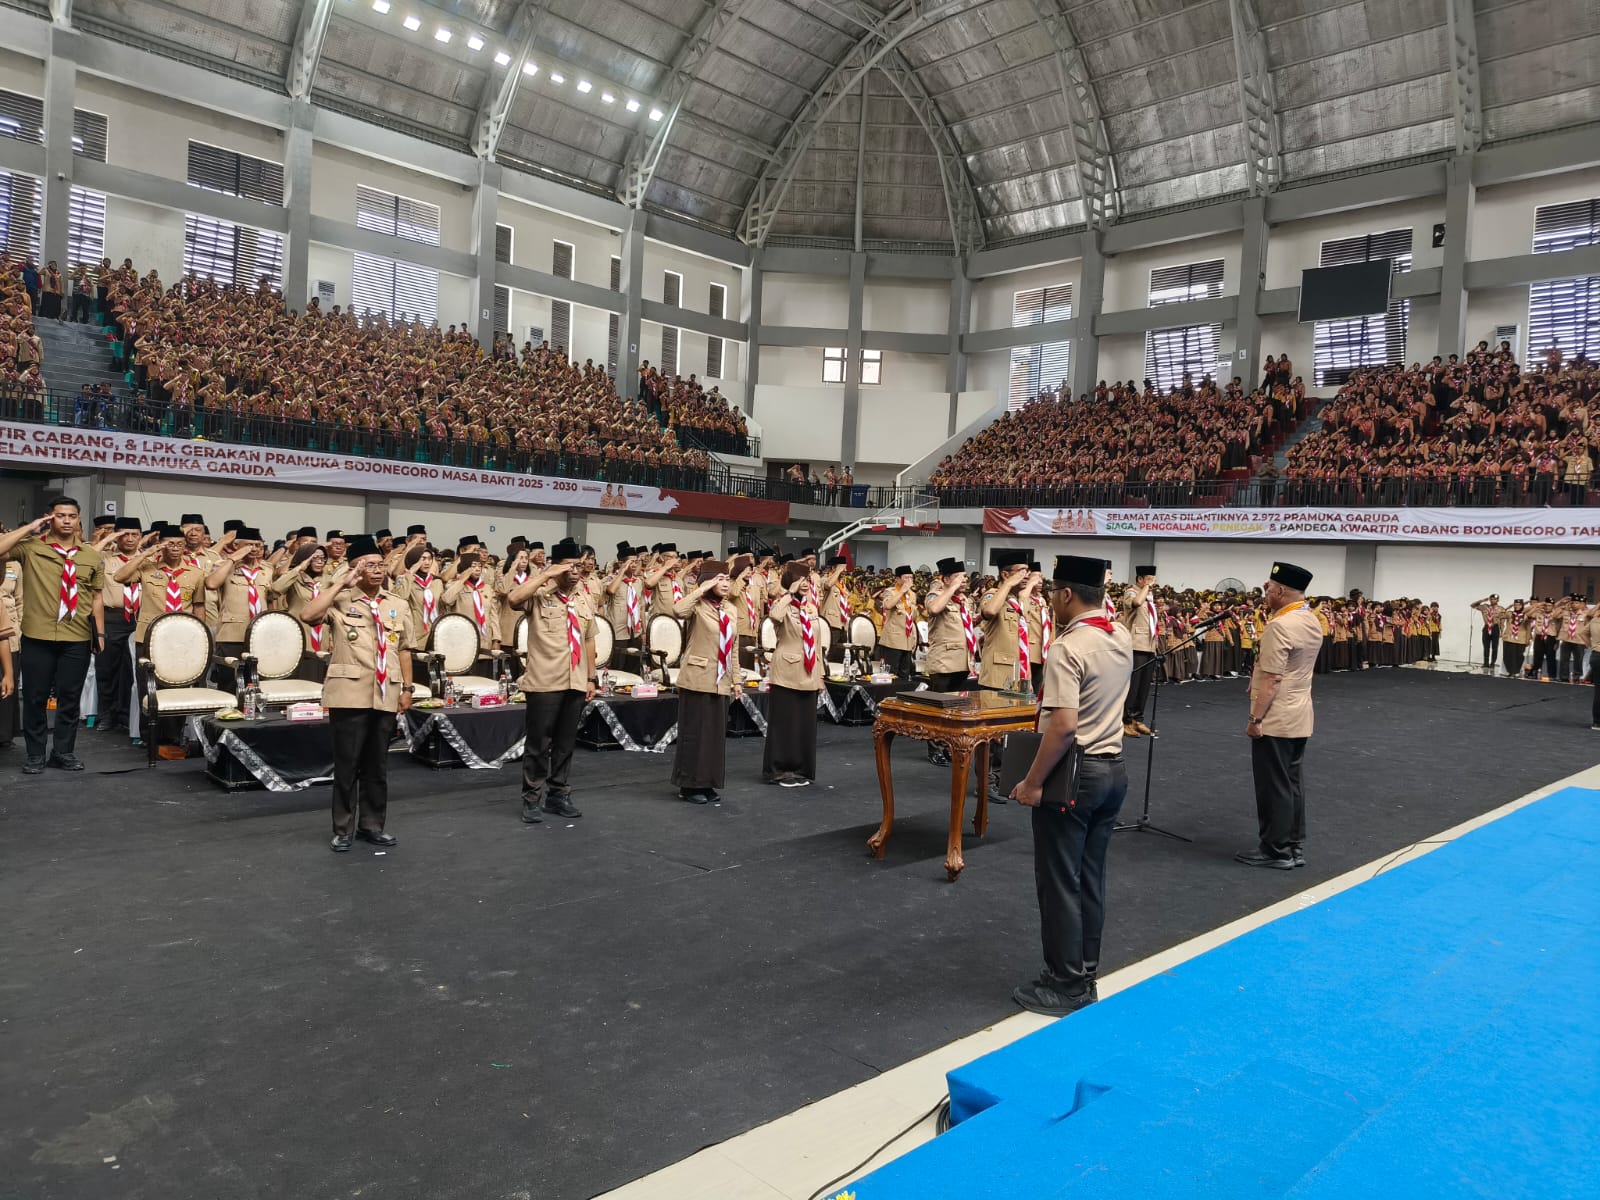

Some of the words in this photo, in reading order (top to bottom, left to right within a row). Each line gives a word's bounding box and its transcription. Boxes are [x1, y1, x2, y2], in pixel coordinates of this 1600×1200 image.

[0, 441, 107, 462] ELANTIKAN
[112, 452, 201, 471] PRAMUKA
[207, 461, 276, 477] GARUDA
[32, 430, 119, 451] CABANG,
[125, 439, 136, 451] &
[143, 441, 176, 454] LPK
[181, 445, 260, 462] GERAKAN
[265, 452, 341, 469] PRAMUKA
[442, 469, 478, 483] MASA
[481, 473, 515, 487] BAKTI
[518, 478, 543, 489] 2025
[553, 481, 577, 492] 2030
[106, 503, 115, 512] C
[1107, 513, 1150, 521] SELAMAT
[1152, 513, 1177, 521] ATAS
[1180, 513, 1249, 522] DILANTIKNYA
[1252, 513, 1280, 522] 2.972
[1284, 513, 1342, 522] PRAMUKA
[1346, 513, 1399, 522] GARUDA
[1106, 522, 1137, 531] SIAGA,
[1140, 523, 1209, 532] PENGGALANG,
[1269, 523, 1277, 532] &
[1280, 523, 1337, 532] PANDEGA
[1340, 524, 1399, 533] KWARTIR
[1402, 525, 1459, 535] CABANG
[1463, 526, 1566, 536] BOJONEGORO
[1571, 526, 1600, 536] TAH
